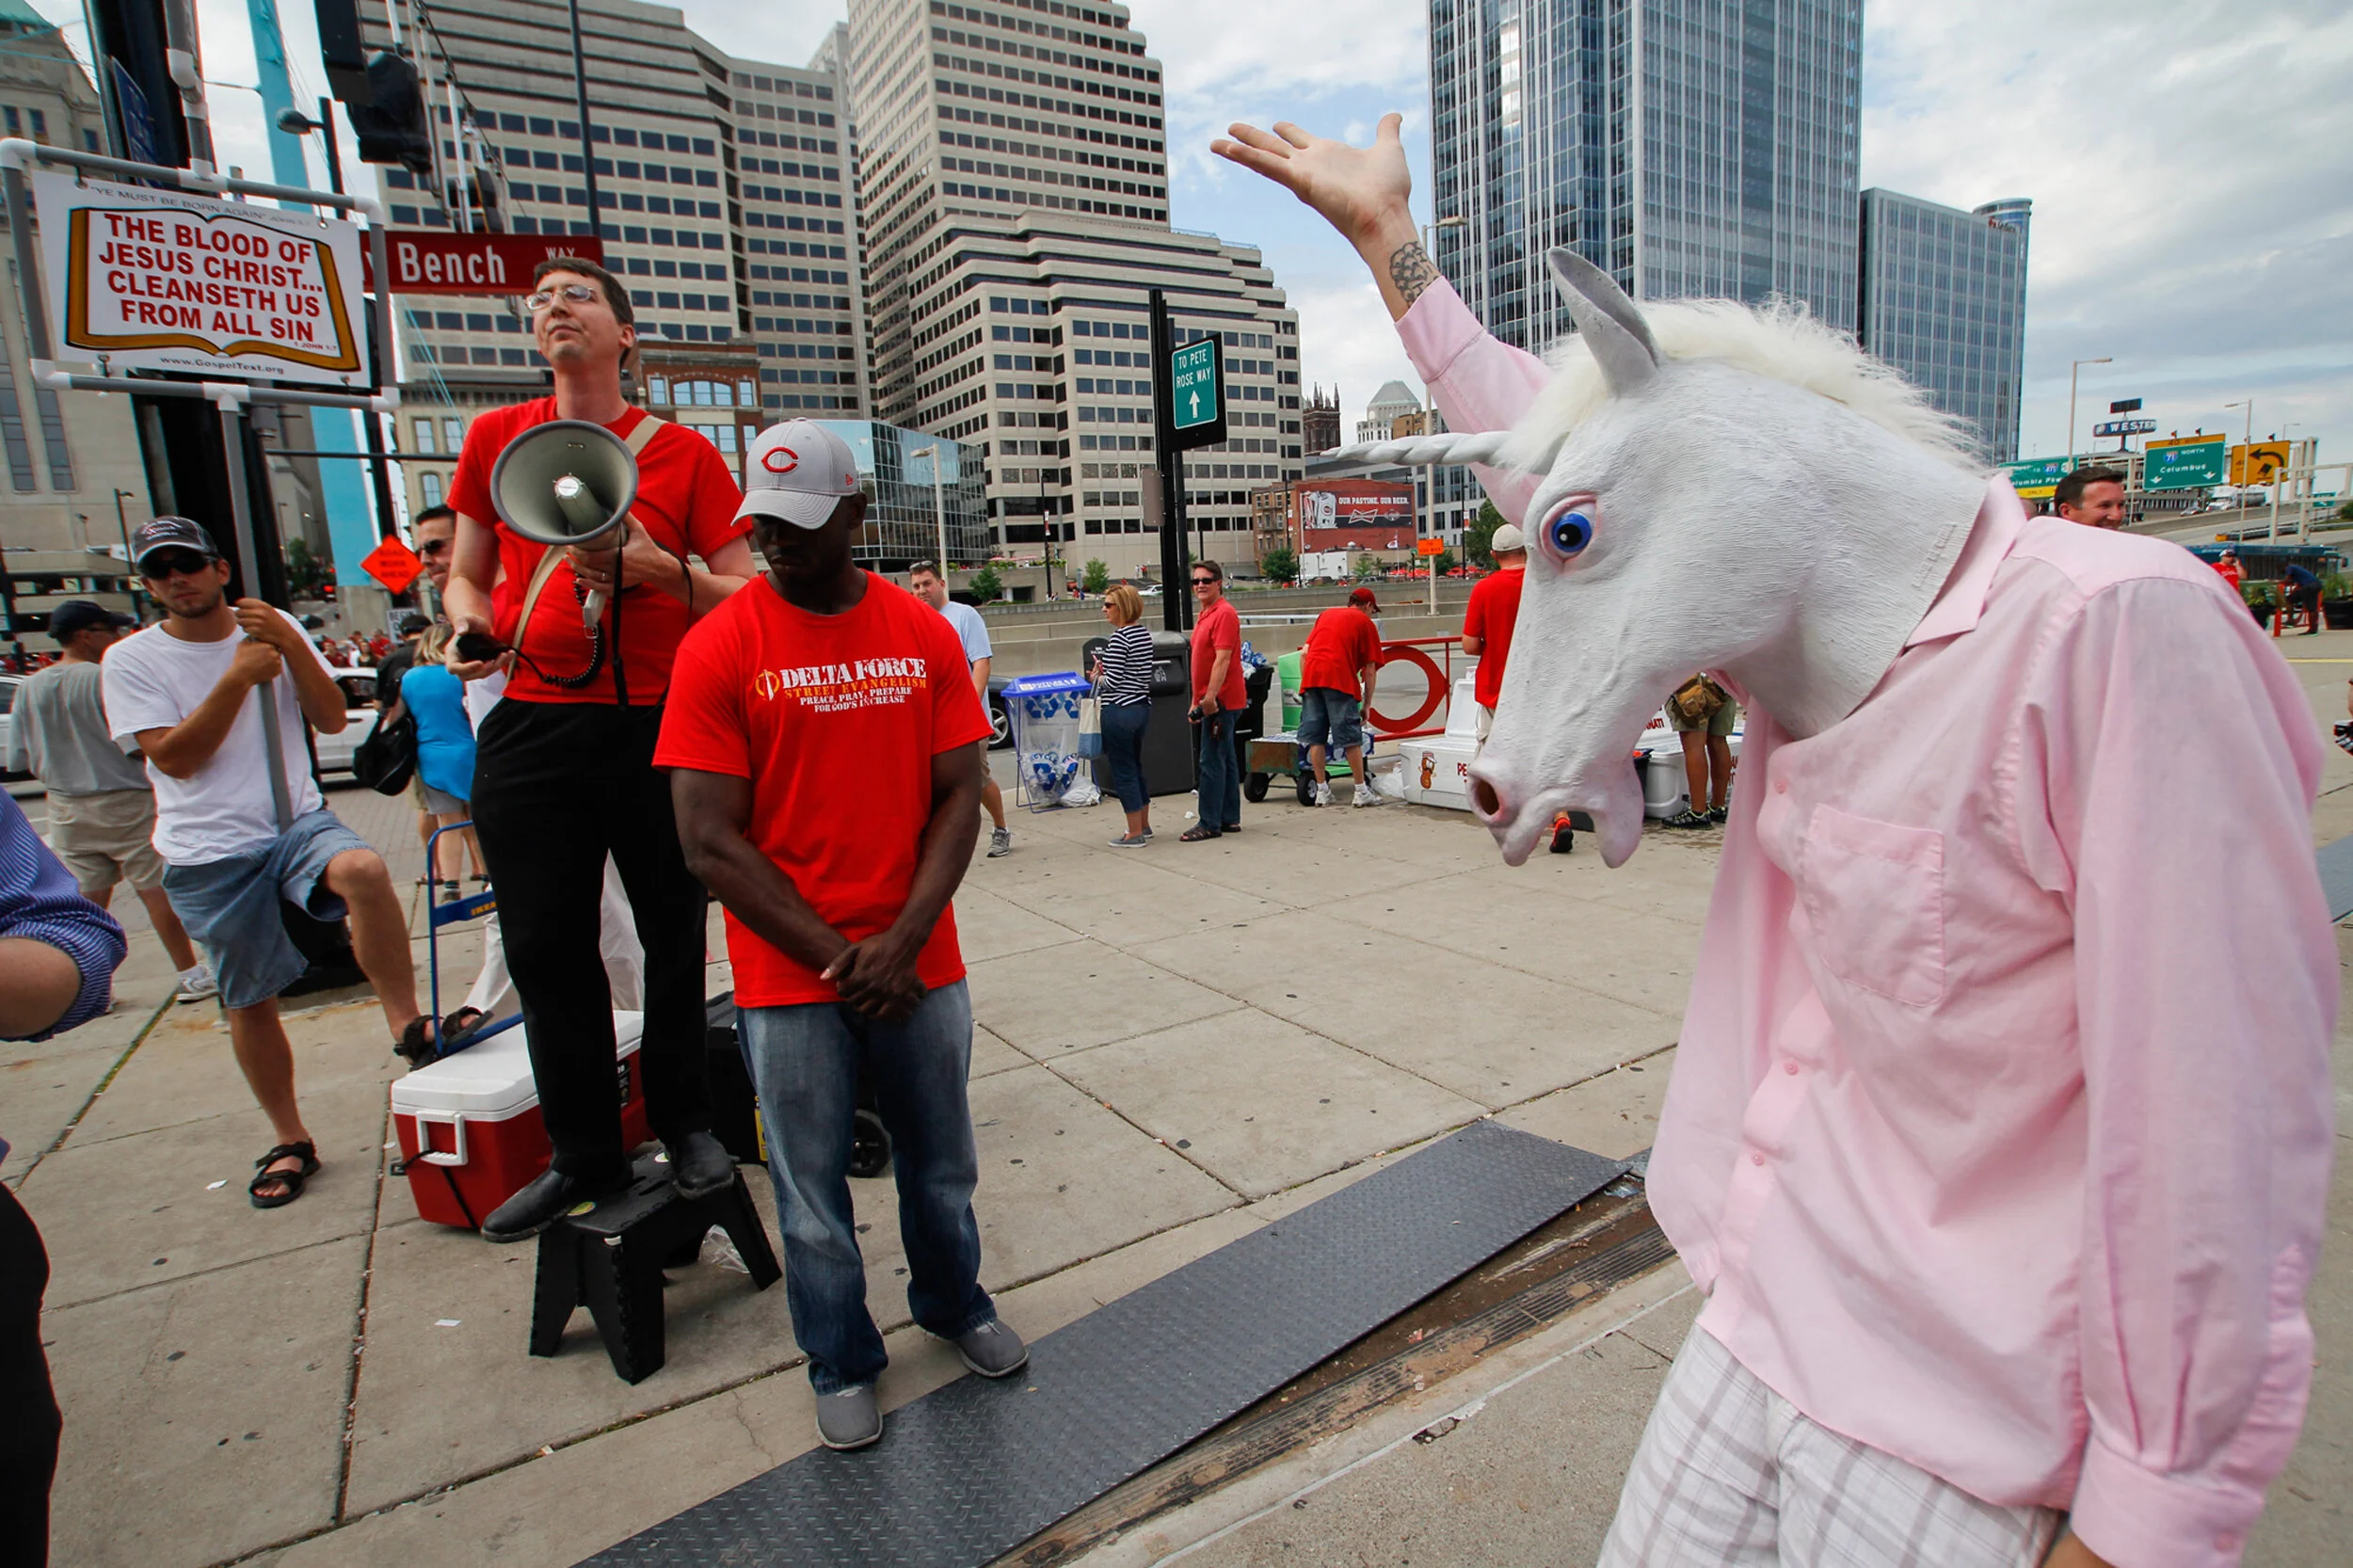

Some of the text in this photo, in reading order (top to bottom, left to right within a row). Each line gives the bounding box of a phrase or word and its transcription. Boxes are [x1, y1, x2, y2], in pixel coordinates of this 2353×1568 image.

[119, 190, 156, 203] MUST
[161, 197, 177, 207] BE
[183, 200, 219, 214] BORN
[104, 213, 312, 264] THE BLOOD OF
[99, 241, 194, 275] JESUS
[203, 256, 323, 293] CHRIST...
[396, 242, 506, 284] Bench
[545, 246, 575, 262] WAY
[107, 270, 320, 317] CLEANSETH US
[120, 298, 313, 342] FROM ALL SIN
[159, 357, 284, 375] www.GospelText.org
[1178, 348, 1208, 370] TO PETE
[1176, 367, 1211, 389] ROSE WAY
[760, 446, 799, 474] C
[2181, 447, 2205, 456] NORTH
[2159, 463, 2207, 473] Columbus
[2011, 478, 2042, 487] olumbia
[1338, 497, 1352, 505] OUR
[1380, 497, 1392, 505] OUR
[779, 657, 927, 689] DELTA FORCE
[784, 677, 927, 699] STREET EVANGELISM
[840, 692, 867, 702] PRAY,
[870, 686, 913, 697] PREPARE
[815, 695, 905, 713] FOR GOD'S INCREASE
